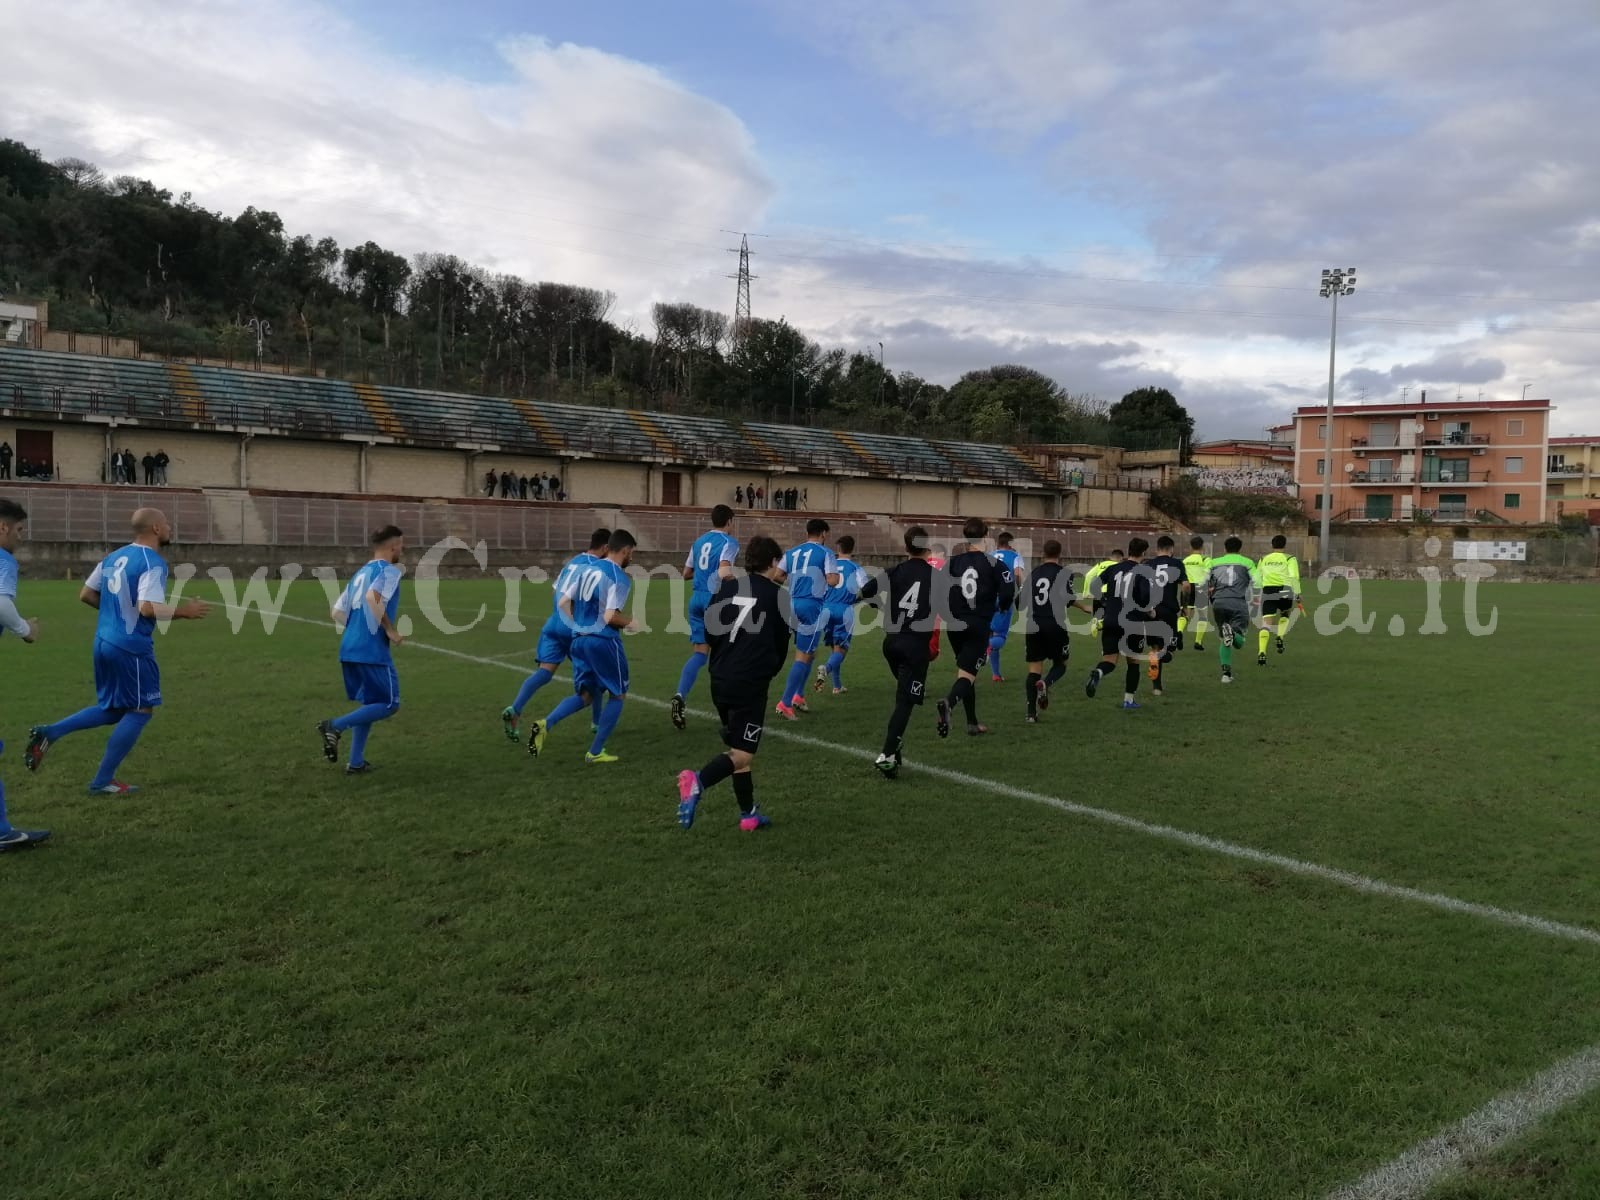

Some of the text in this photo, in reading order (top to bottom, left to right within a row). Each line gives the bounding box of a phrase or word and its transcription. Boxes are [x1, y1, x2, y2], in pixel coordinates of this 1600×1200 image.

[699, 542, 712, 570] 8
[791, 549, 813, 575] 11
[107, 556, 129, 595] 3
[580, 568, 602, 602] 10
[961, 568, 979, 600] 6
[1114, 571, 1133, 599] 11
[1155, 564, 1169, 588] 5
[1226, 565, 1235, 586] 1
[898, 581, 921, 619] 4
[1034, 577, 1051, 606] 3
[730, 596, 758, 643] 7
